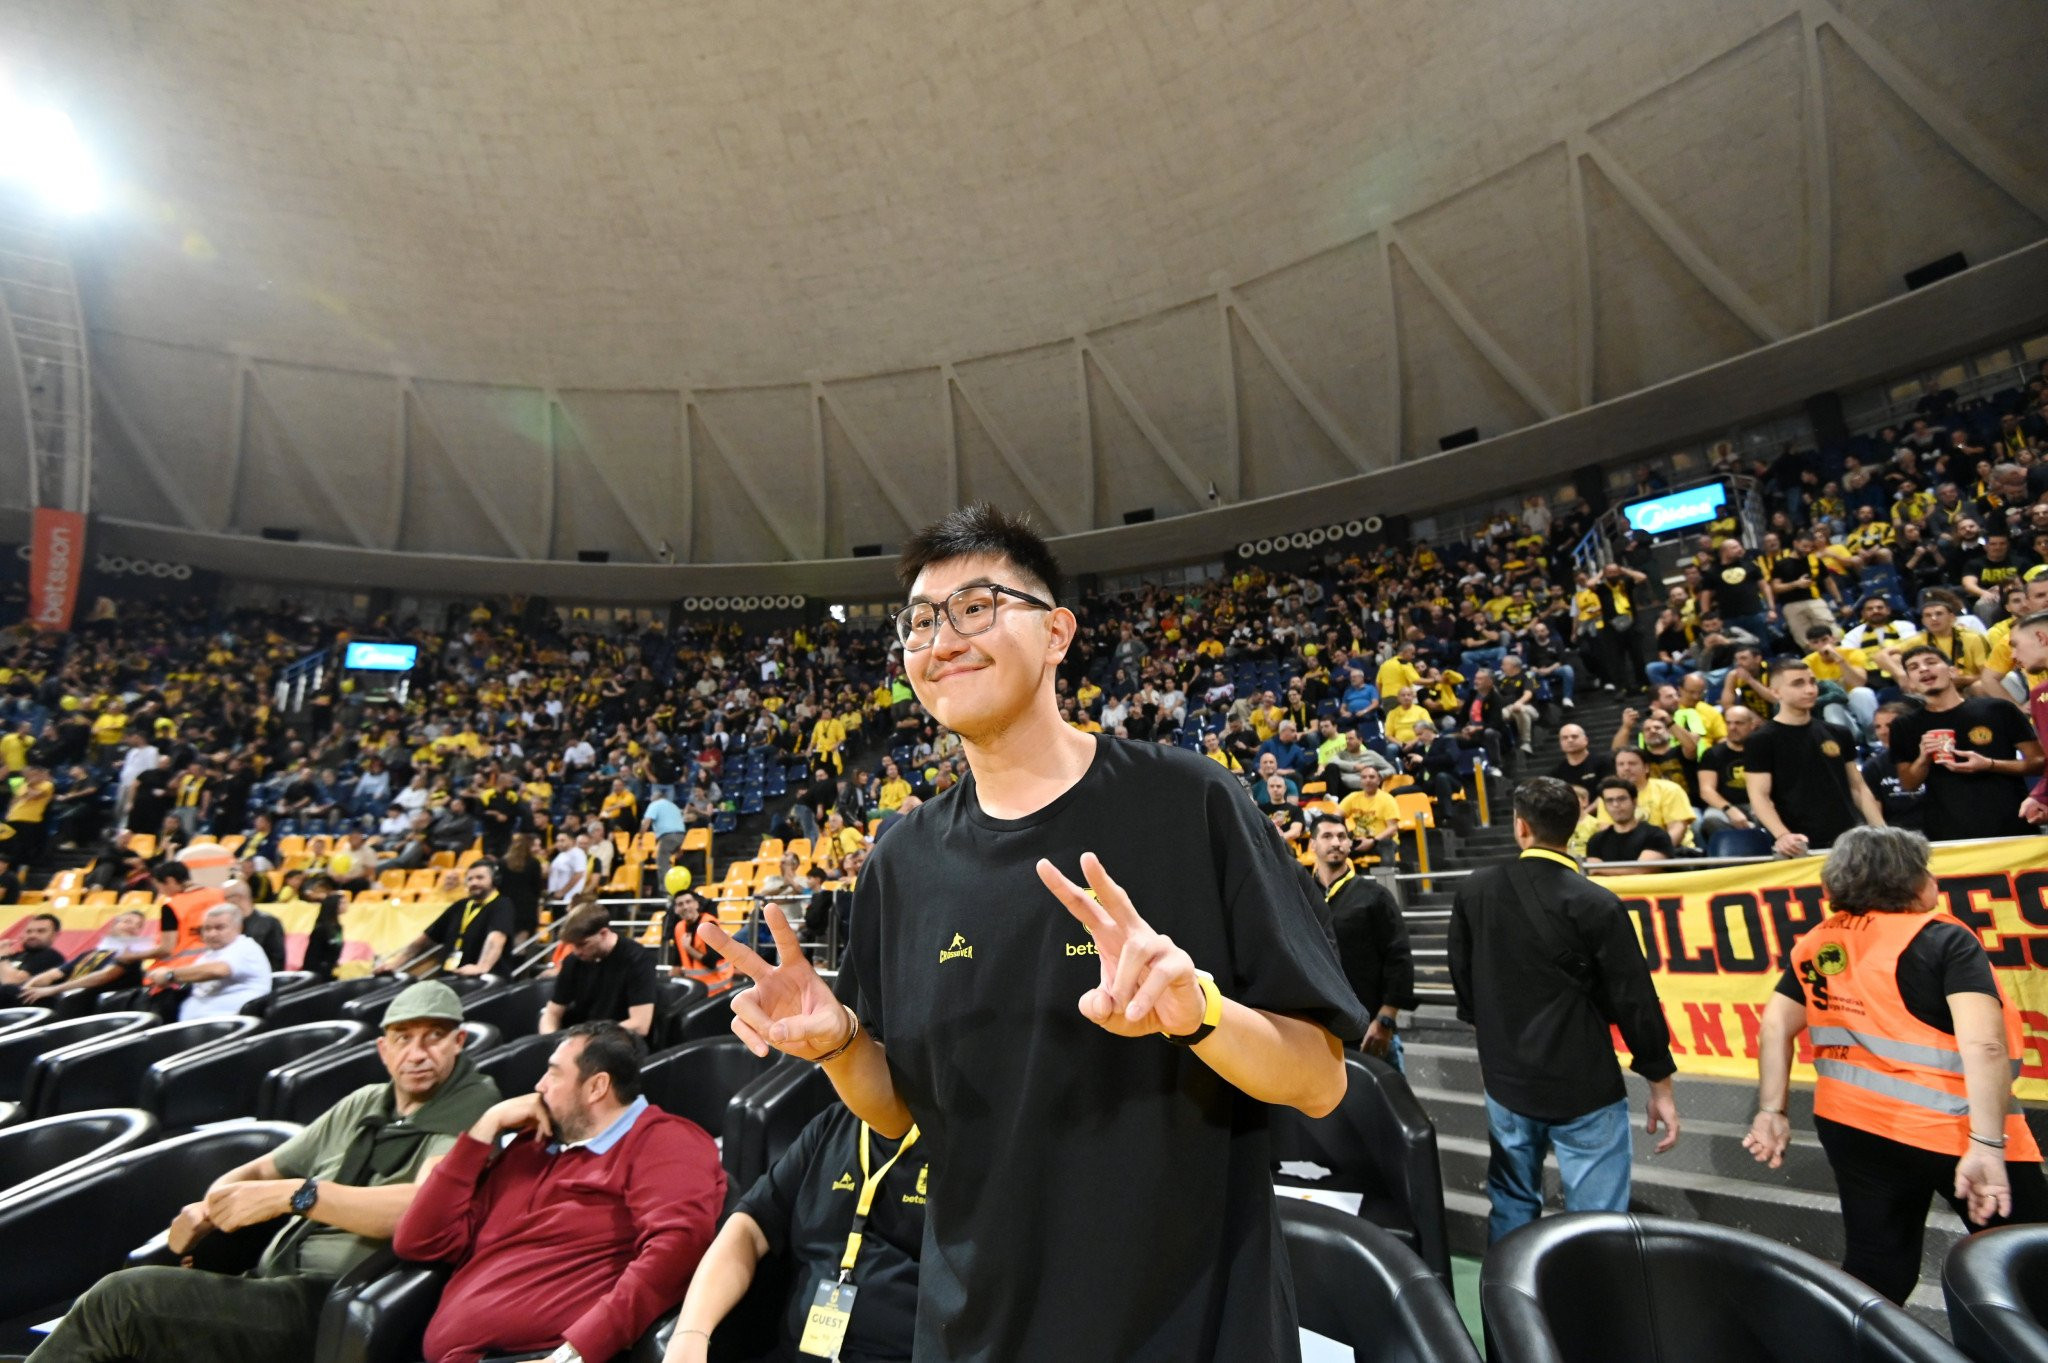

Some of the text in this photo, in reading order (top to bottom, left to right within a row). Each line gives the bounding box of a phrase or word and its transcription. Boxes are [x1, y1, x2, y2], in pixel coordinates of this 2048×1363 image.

[37, 527, 71, 623] betsson
[939, 945, 973, 964] CROSSOVER
[1065, 941, 1100, 956] bets
[812, 1313, 844, 1329] GUEST
